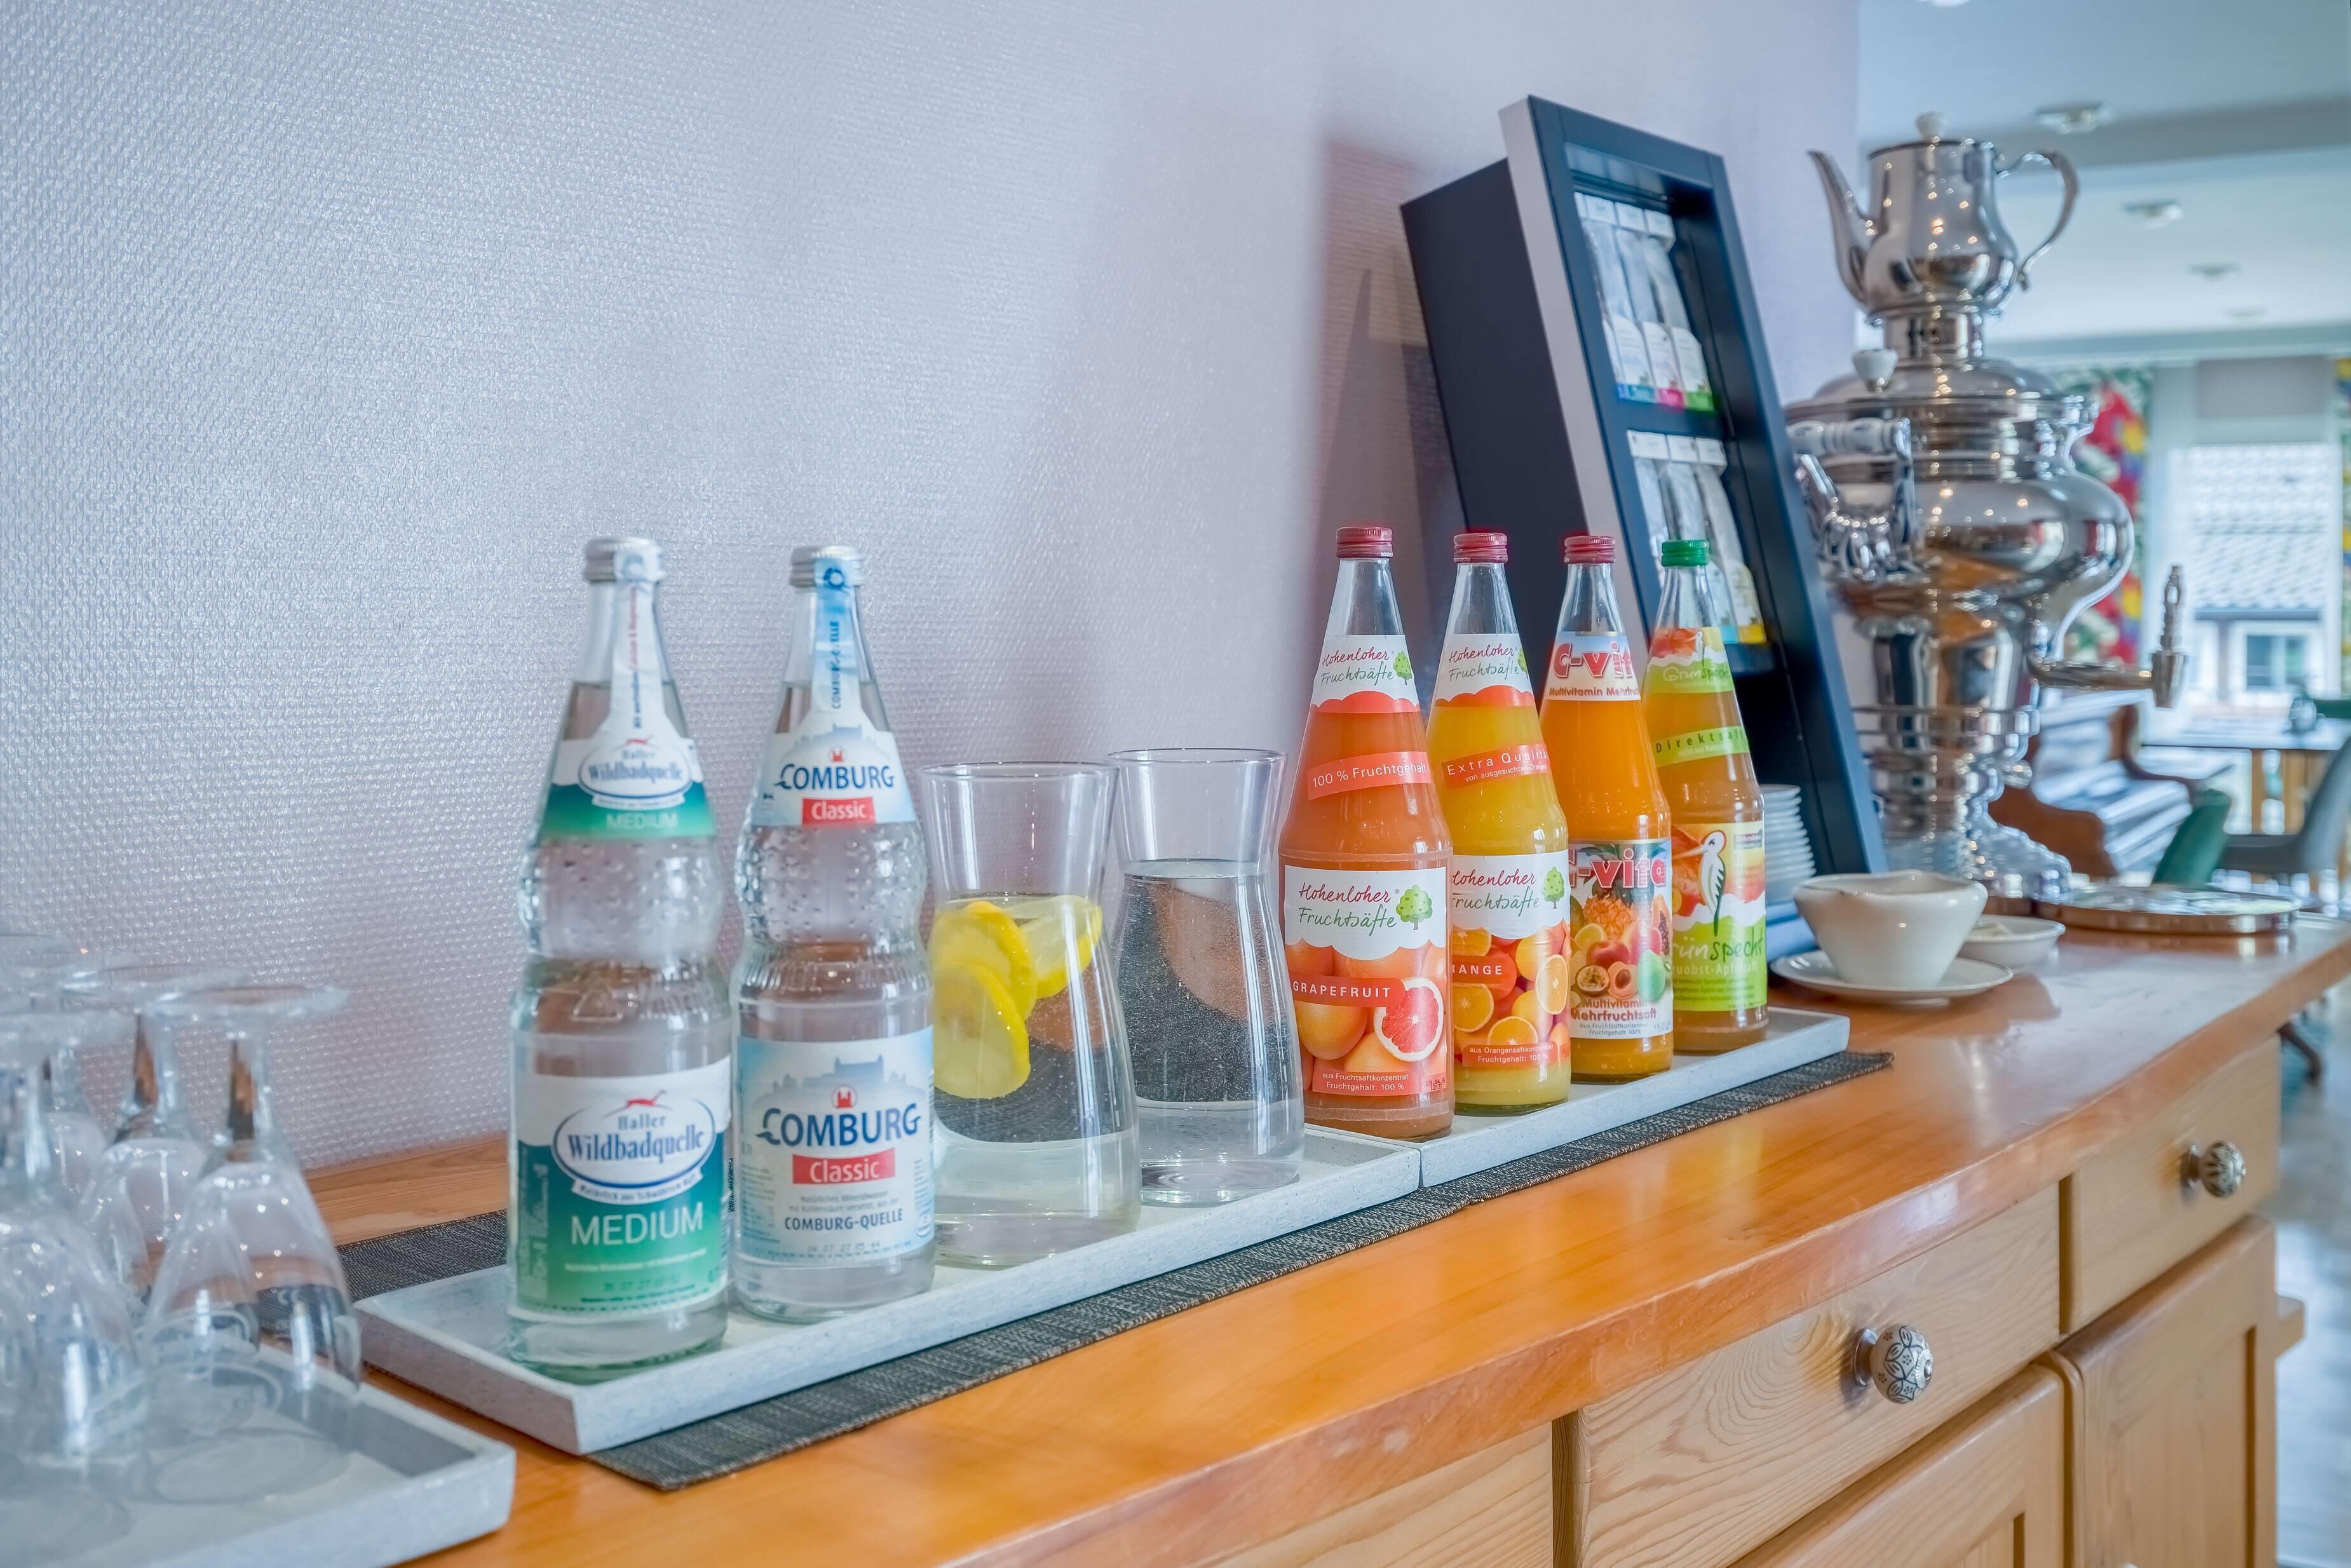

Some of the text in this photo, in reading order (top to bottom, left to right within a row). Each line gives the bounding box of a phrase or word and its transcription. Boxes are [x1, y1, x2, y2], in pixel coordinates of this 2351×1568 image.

[1322, 646, 1390, 667] Hohenloher
[1449, 643, 1515, 663] Hohenloher
[1321, 661, 1395, 686] Fruchtsäfte
[1449, 657, 1520, 682] Fruchtsäfte
[774, 763, 895, 790] COMBURG
[1313, 762, 1427, 788] 100 % Fruchtgehalt
[1447, 758, 1494, 776] Extra
[811, 800, 866, 820] Classic
[606, 812, 679, 830] MEDIUM
[1299, 882, 1391, 903] Hohenloher
[1299, 903, 1397, 936] Fruchtsäfte
[1292, 981, 1391, 998] GRAPEFRUIT
[1571, 1008, 1657, 1021] Mehrfruchtsaft
[1478, 1055, 1527, 1064] Fruchtgehalt:
[1326, 1081, 1378, 1092] Fruchtgehalt:
[1336, 1072, 1409, 1081] Fruchtsaftkonzentrat
[618, 1114, 667, 1130] Haller
[755, 1103, 921, 1147] COMBURG
[567, 1124, 704, 1164] Wildbadquelle
[810, 1158, 880, 1184] Classic
[571, 1202, 703, 1246] MEDIUM
[784, 1208, 904, 1231] COMBURG-QUELLE
